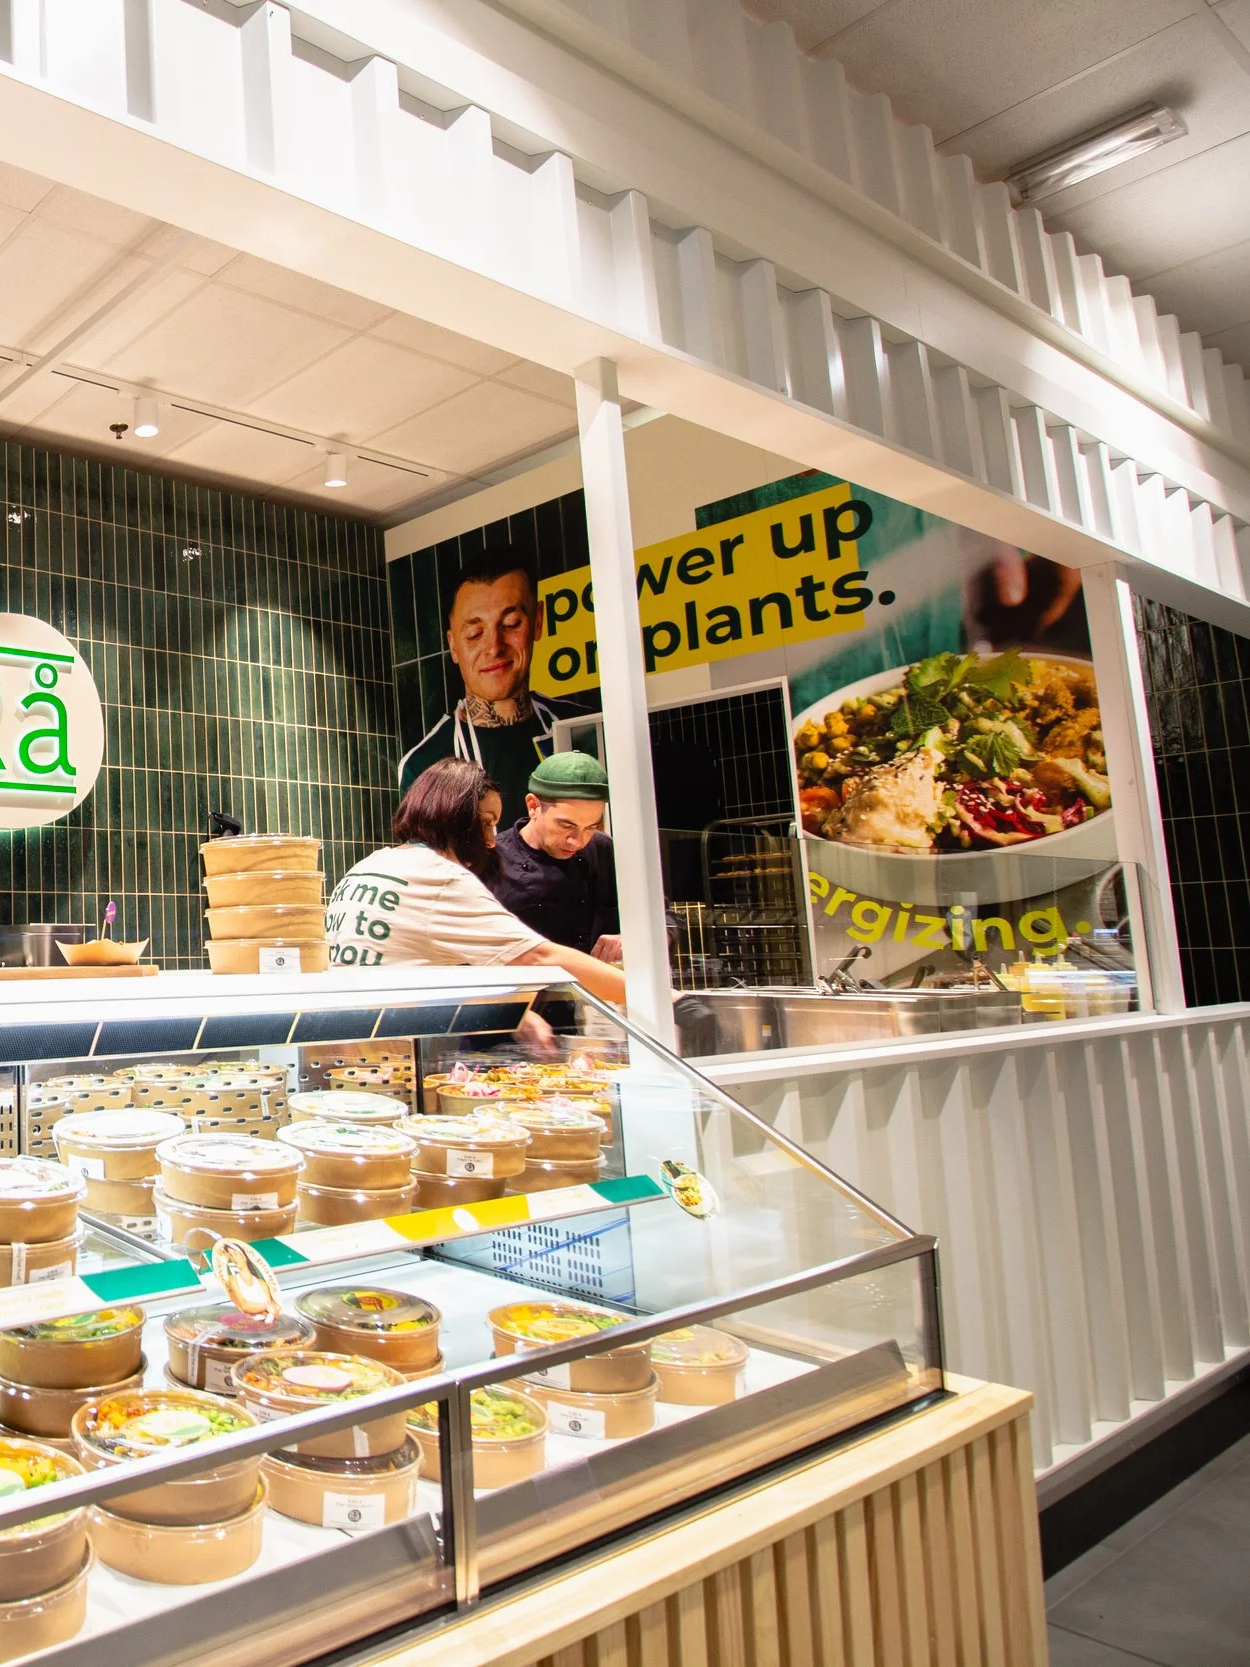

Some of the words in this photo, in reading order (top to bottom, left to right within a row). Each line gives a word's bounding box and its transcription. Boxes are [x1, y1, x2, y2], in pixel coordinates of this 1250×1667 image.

[544, 534, 744, 637] pwer
[770, 500, 873, 561] up
[645, 570, 896, 673] plants.
[350, 883, 400, 911] me
[355, 910, 391, 940] to
[809, 871, 1092, 957] ergizing.
